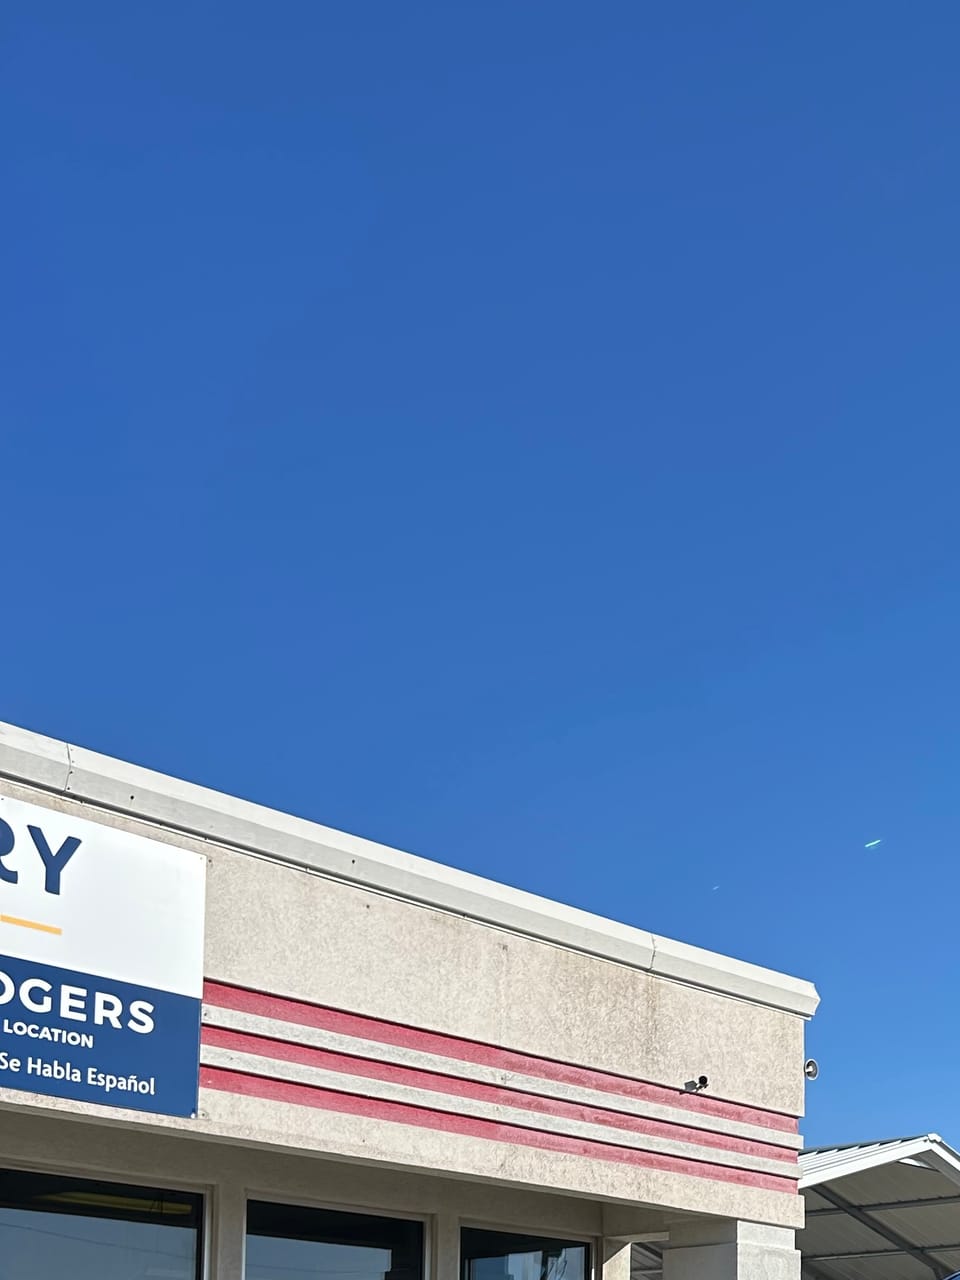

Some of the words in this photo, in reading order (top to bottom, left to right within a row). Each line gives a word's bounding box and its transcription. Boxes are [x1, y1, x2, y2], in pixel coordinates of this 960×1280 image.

[4, 1019, 94, 1049] LOCATION
[0, 1052, 21, 1072] Se
[27, 1056, 82, 1083] Habla
[87, 1067, 156, 1096] Español
